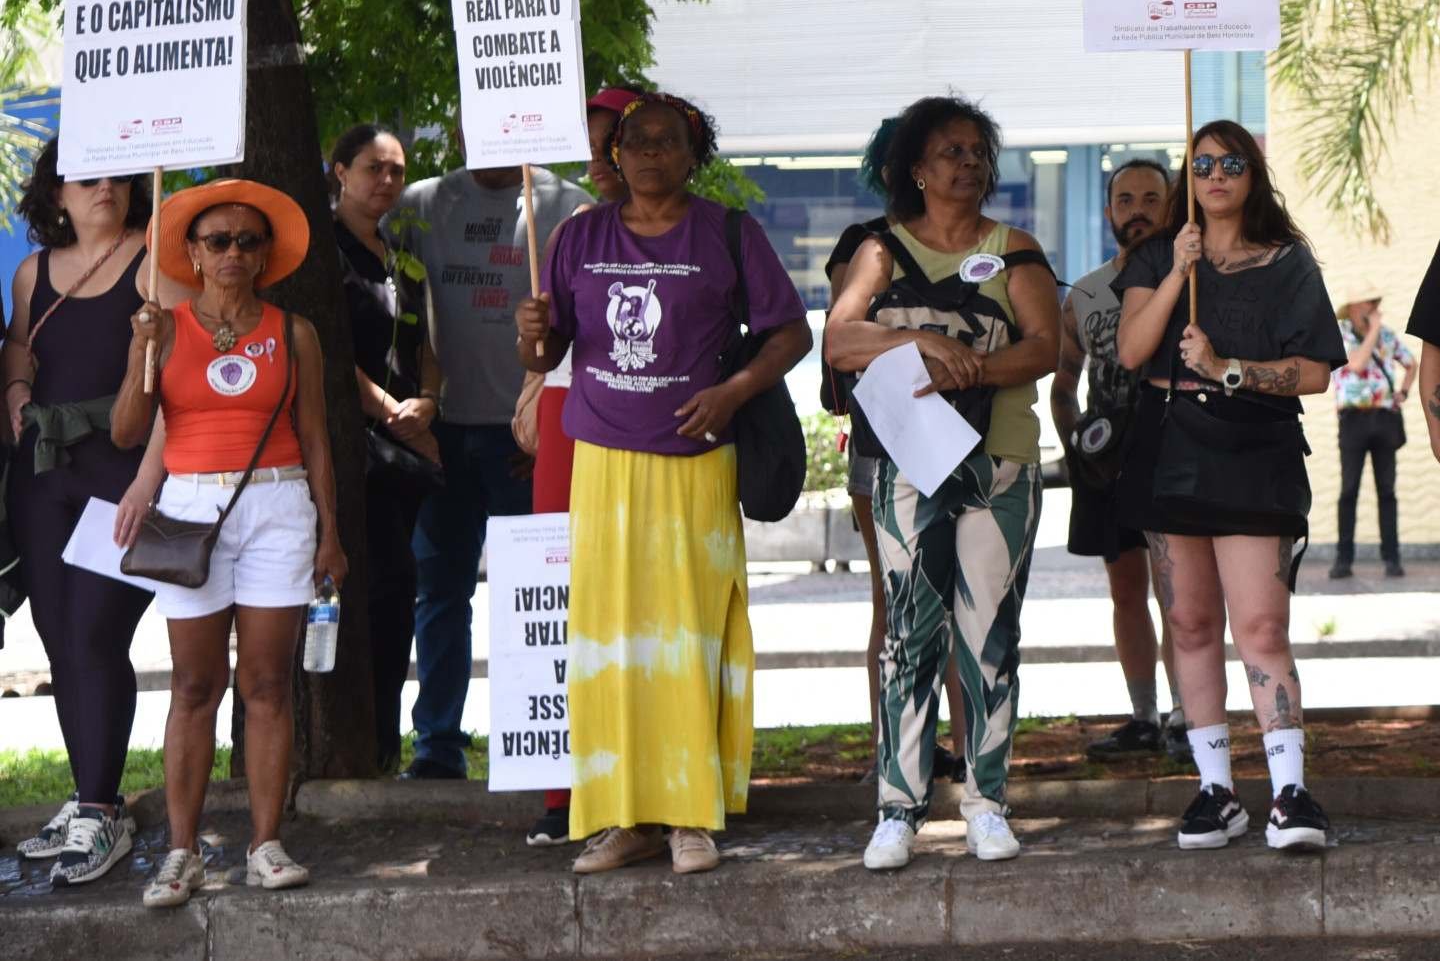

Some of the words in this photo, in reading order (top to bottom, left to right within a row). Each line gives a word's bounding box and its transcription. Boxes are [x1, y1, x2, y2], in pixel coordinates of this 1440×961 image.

[76, 5, 86, 35] E
[91, 4, 103, 33] O
[473, 31, 546, 58] COMBATE
[551, 30, 560, 52] A
[75, 49, 111, 83] QUE
[116, 46, 128, 76] O
[133, 36, 233, 74] ALIMENTA!
[475, 63, 561, 89] VIOLÊNCIA!
[465, 223, 501, 235] MUNDO
[442, 271, 503, 285] DIFERENTES
